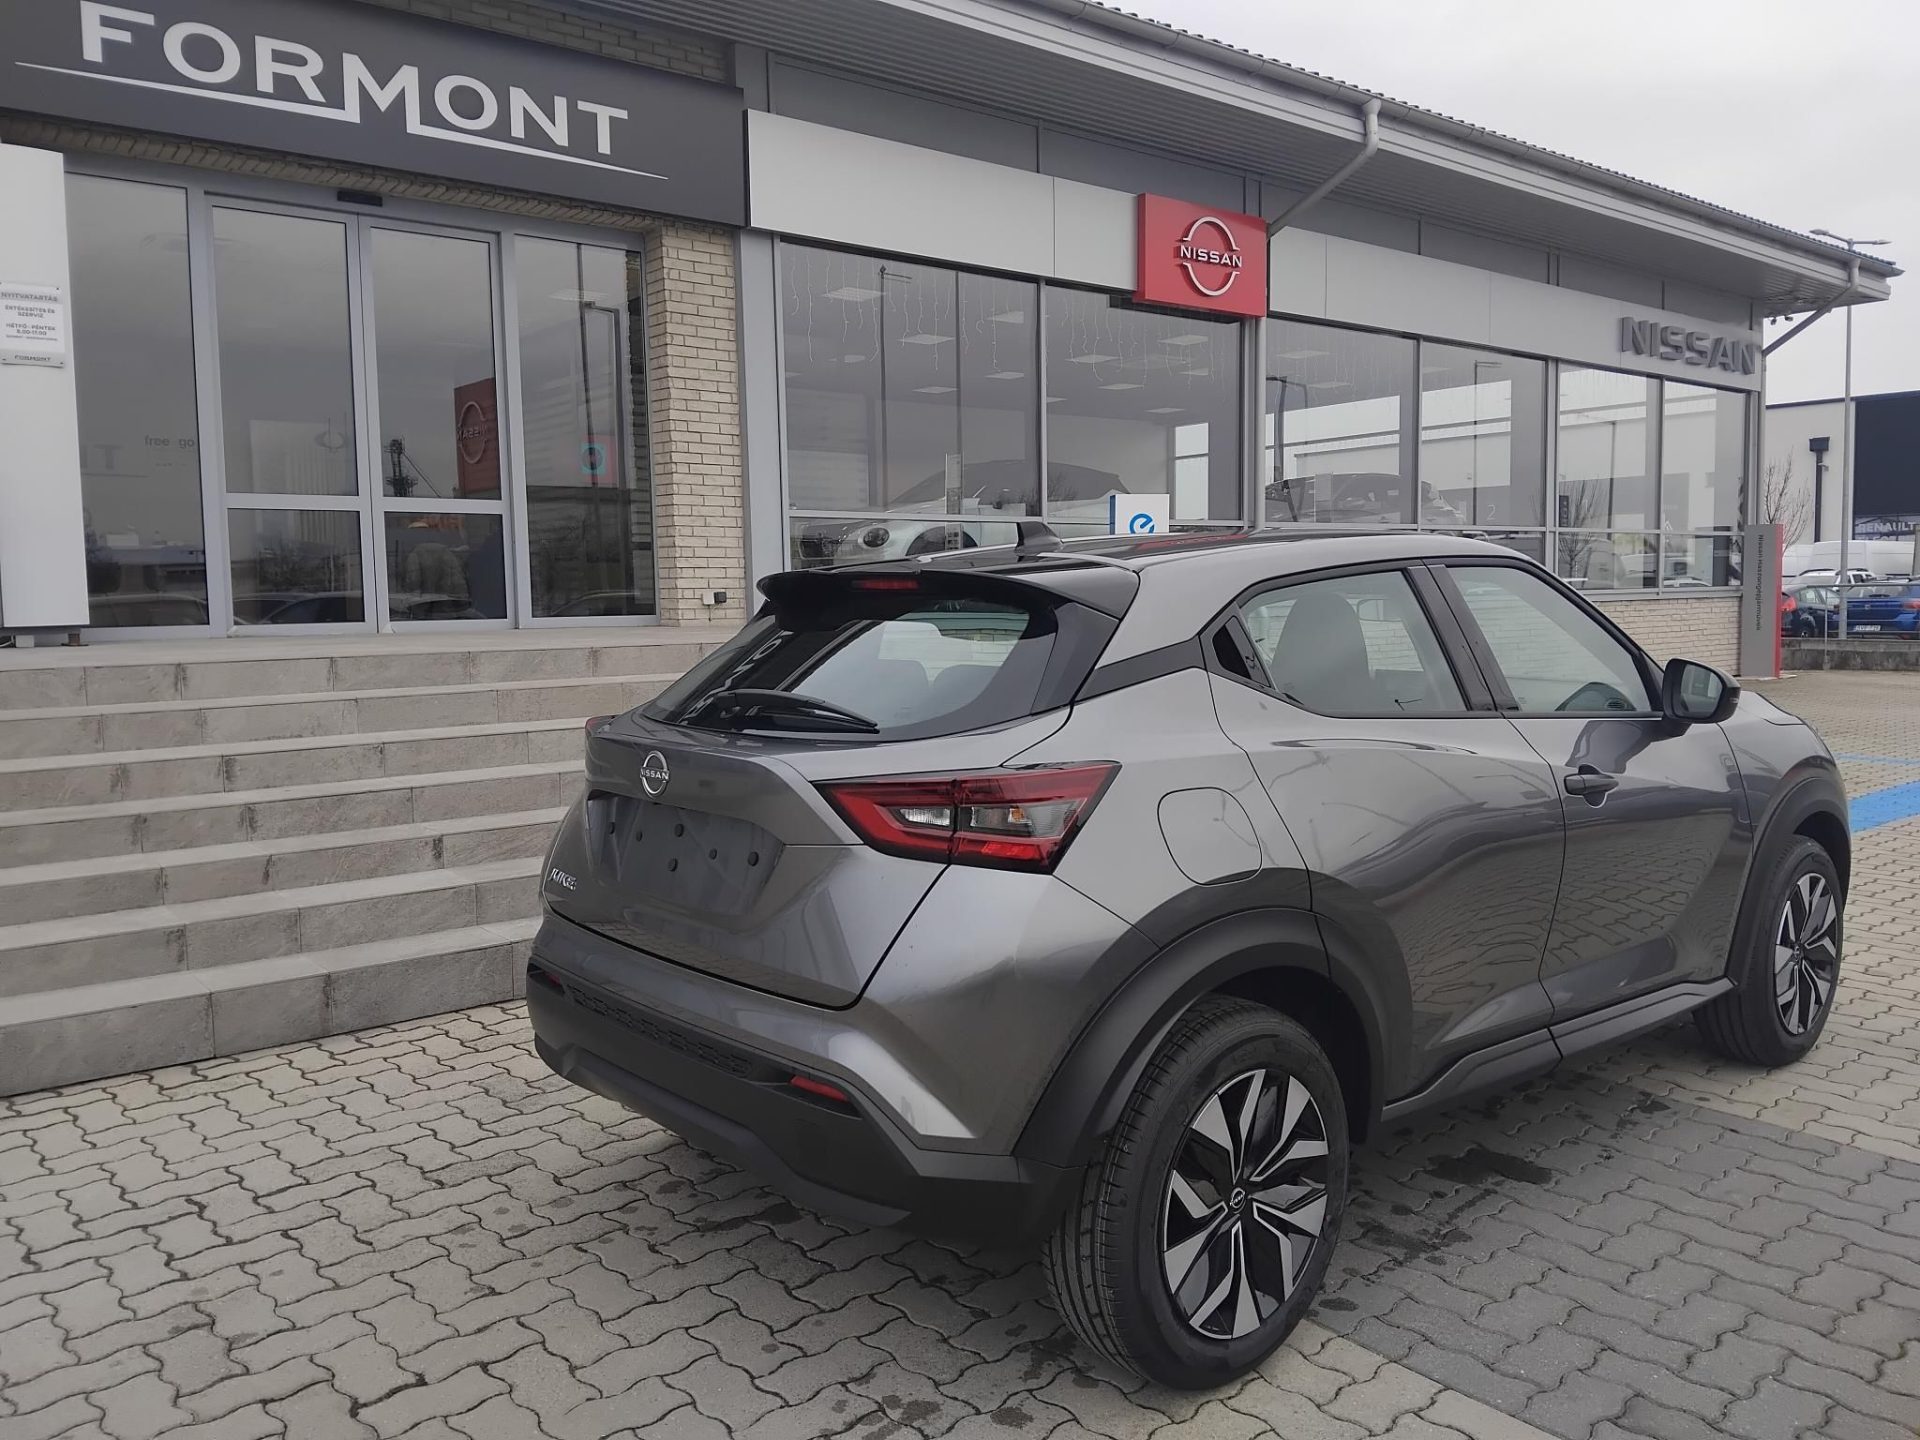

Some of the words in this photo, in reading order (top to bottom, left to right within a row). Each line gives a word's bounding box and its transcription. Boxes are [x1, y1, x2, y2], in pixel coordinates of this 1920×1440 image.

[80, 0, 628, 155] FORMONT
[1180, 245, 1243, 268] NISSAN
[1621, 316, 1756, 375] NISSAN
[144, 434, 170, 447] free
[179, 437, 195, 449] go
[1855, 521, 1917, 533] RENAULT
[640, 767, 670, 780] NISSAN
